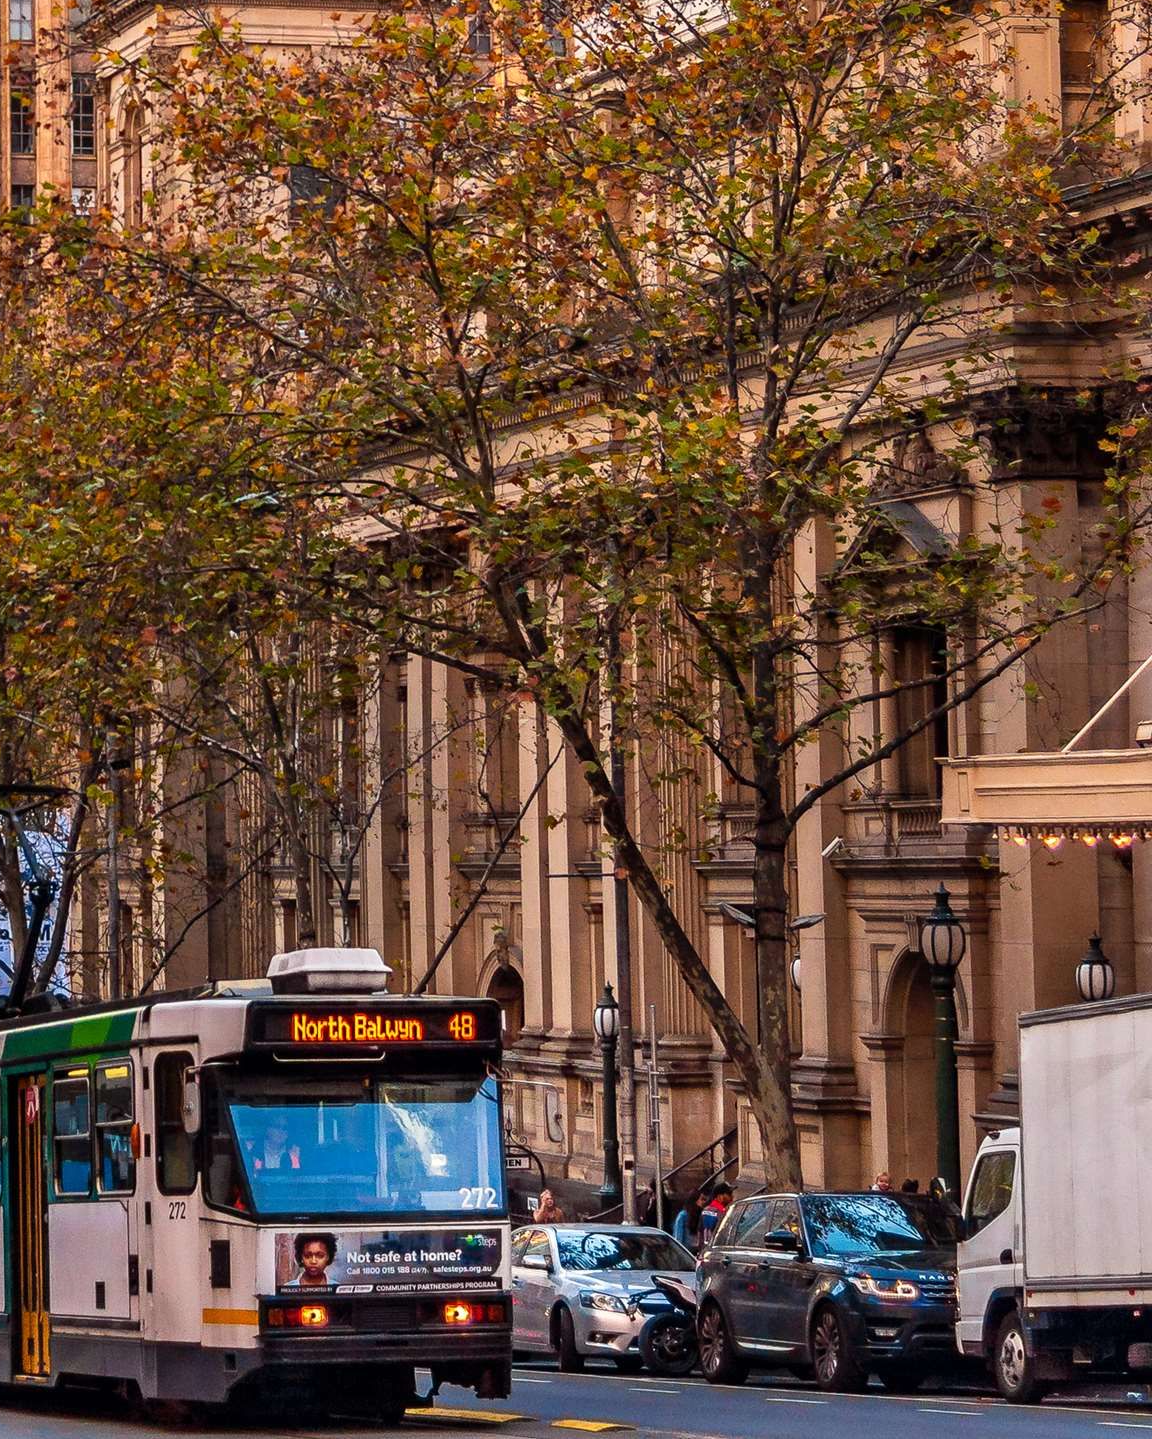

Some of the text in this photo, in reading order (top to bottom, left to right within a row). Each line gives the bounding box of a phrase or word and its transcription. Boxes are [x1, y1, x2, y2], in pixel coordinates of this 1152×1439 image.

[294, 1013, 473, 1041] North Balwyn 48
[459, 1187, 499, 1209] 272
[169, 1201, 186, 1220] 272
[347, 1249, 463, 1264] Not safe at home?
[347, 1267, 360, 1275] Call
[382, 1266, 396, 1274] 015
[433, 1265, 493, 1274] safesteps.org.au
[417, 1283, 464, 1291] PARTNERSHIPS
[465, 1281, 497, 1289] PROGRAM
